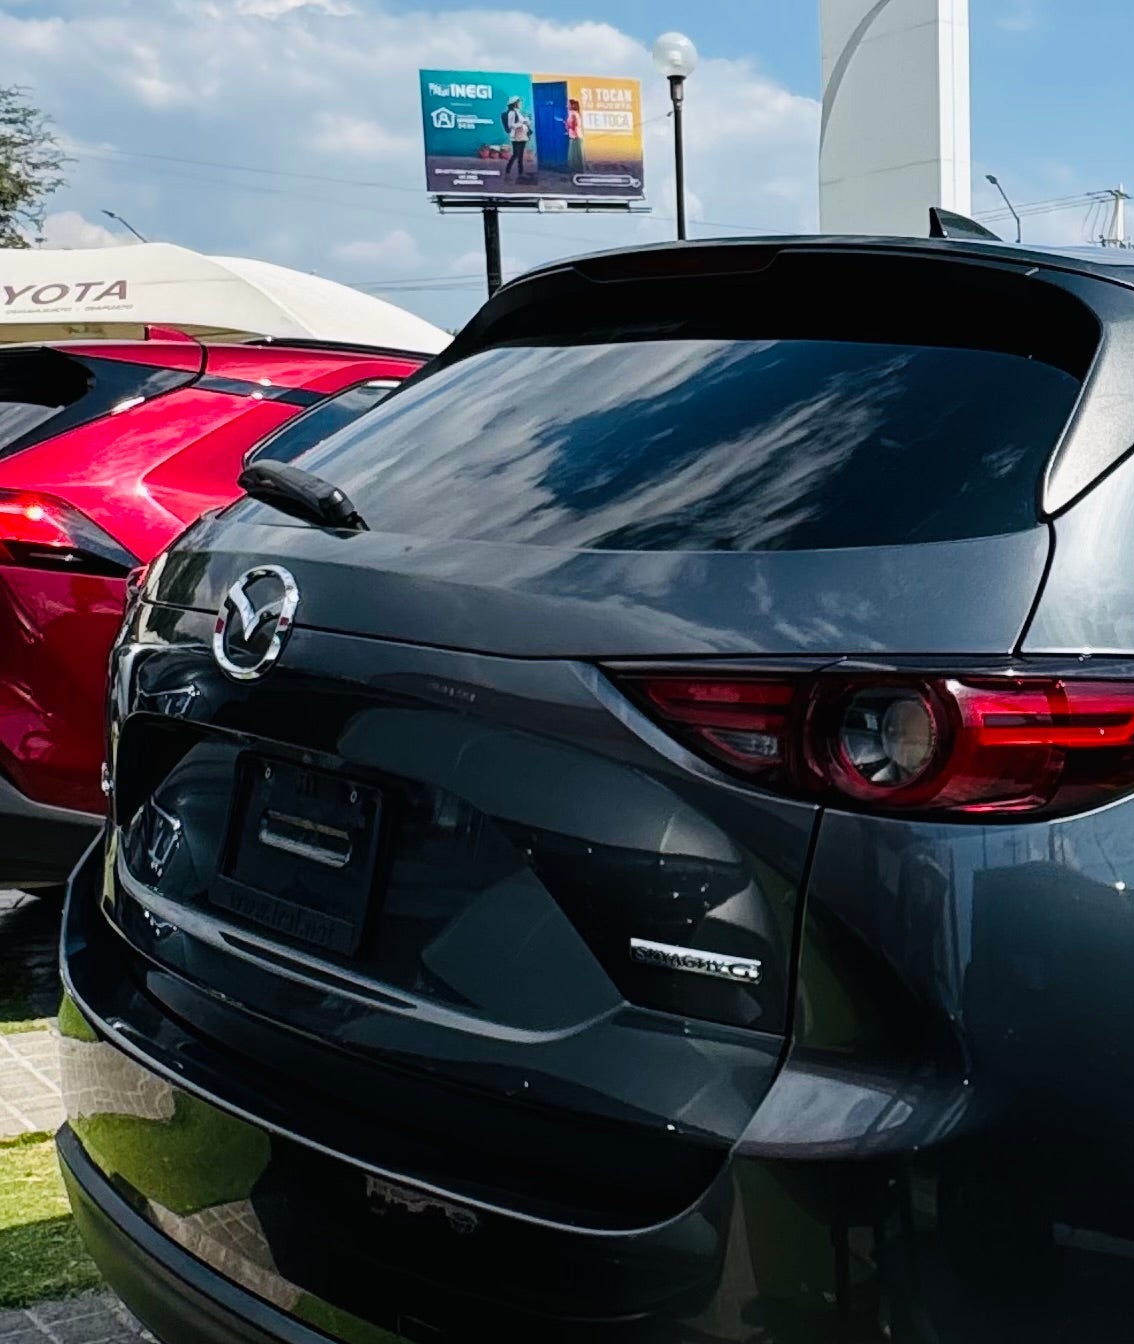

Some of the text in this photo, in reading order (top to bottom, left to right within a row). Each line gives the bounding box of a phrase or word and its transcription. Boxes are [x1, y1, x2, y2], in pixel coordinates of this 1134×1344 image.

[450, 83, 493, 99] INEGI
[581, 88, 632, 102] SI TOCAN
[587, 113, 631, 128] TE TOCA
